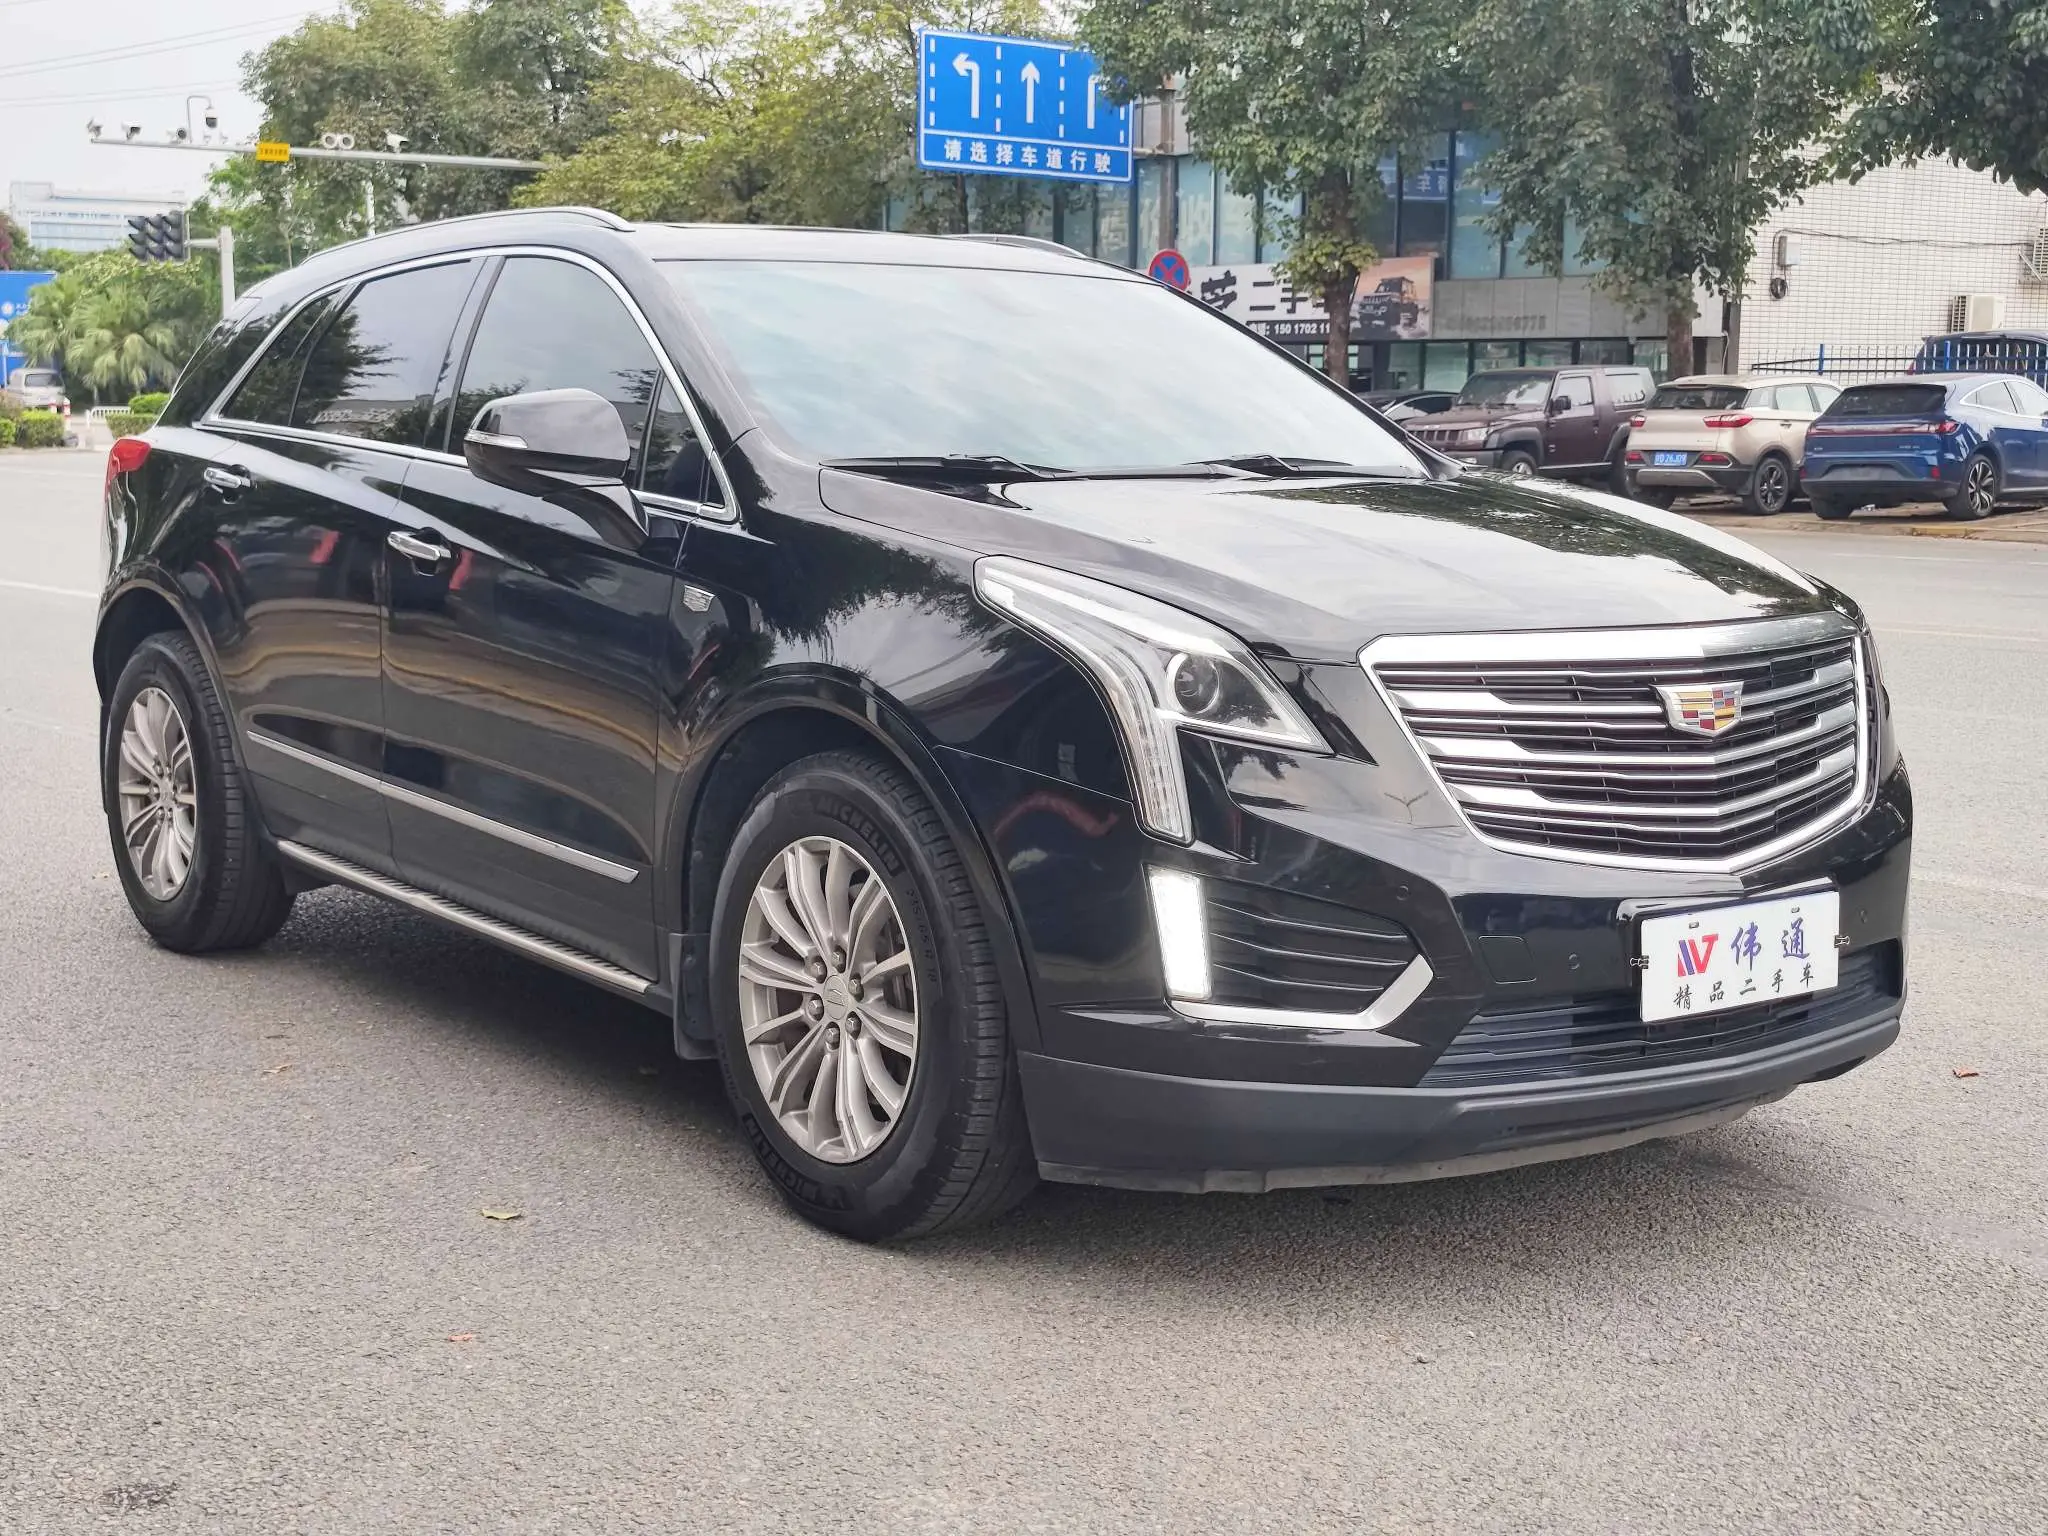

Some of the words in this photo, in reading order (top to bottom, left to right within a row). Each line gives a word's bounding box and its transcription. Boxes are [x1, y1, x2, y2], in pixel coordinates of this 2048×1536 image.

[944, 138, 1111, 173] 请选择车道行驶
[1730, 916, 1810, 972] 伟通
[1673, 963, 1815, 1010] 精品二手车
